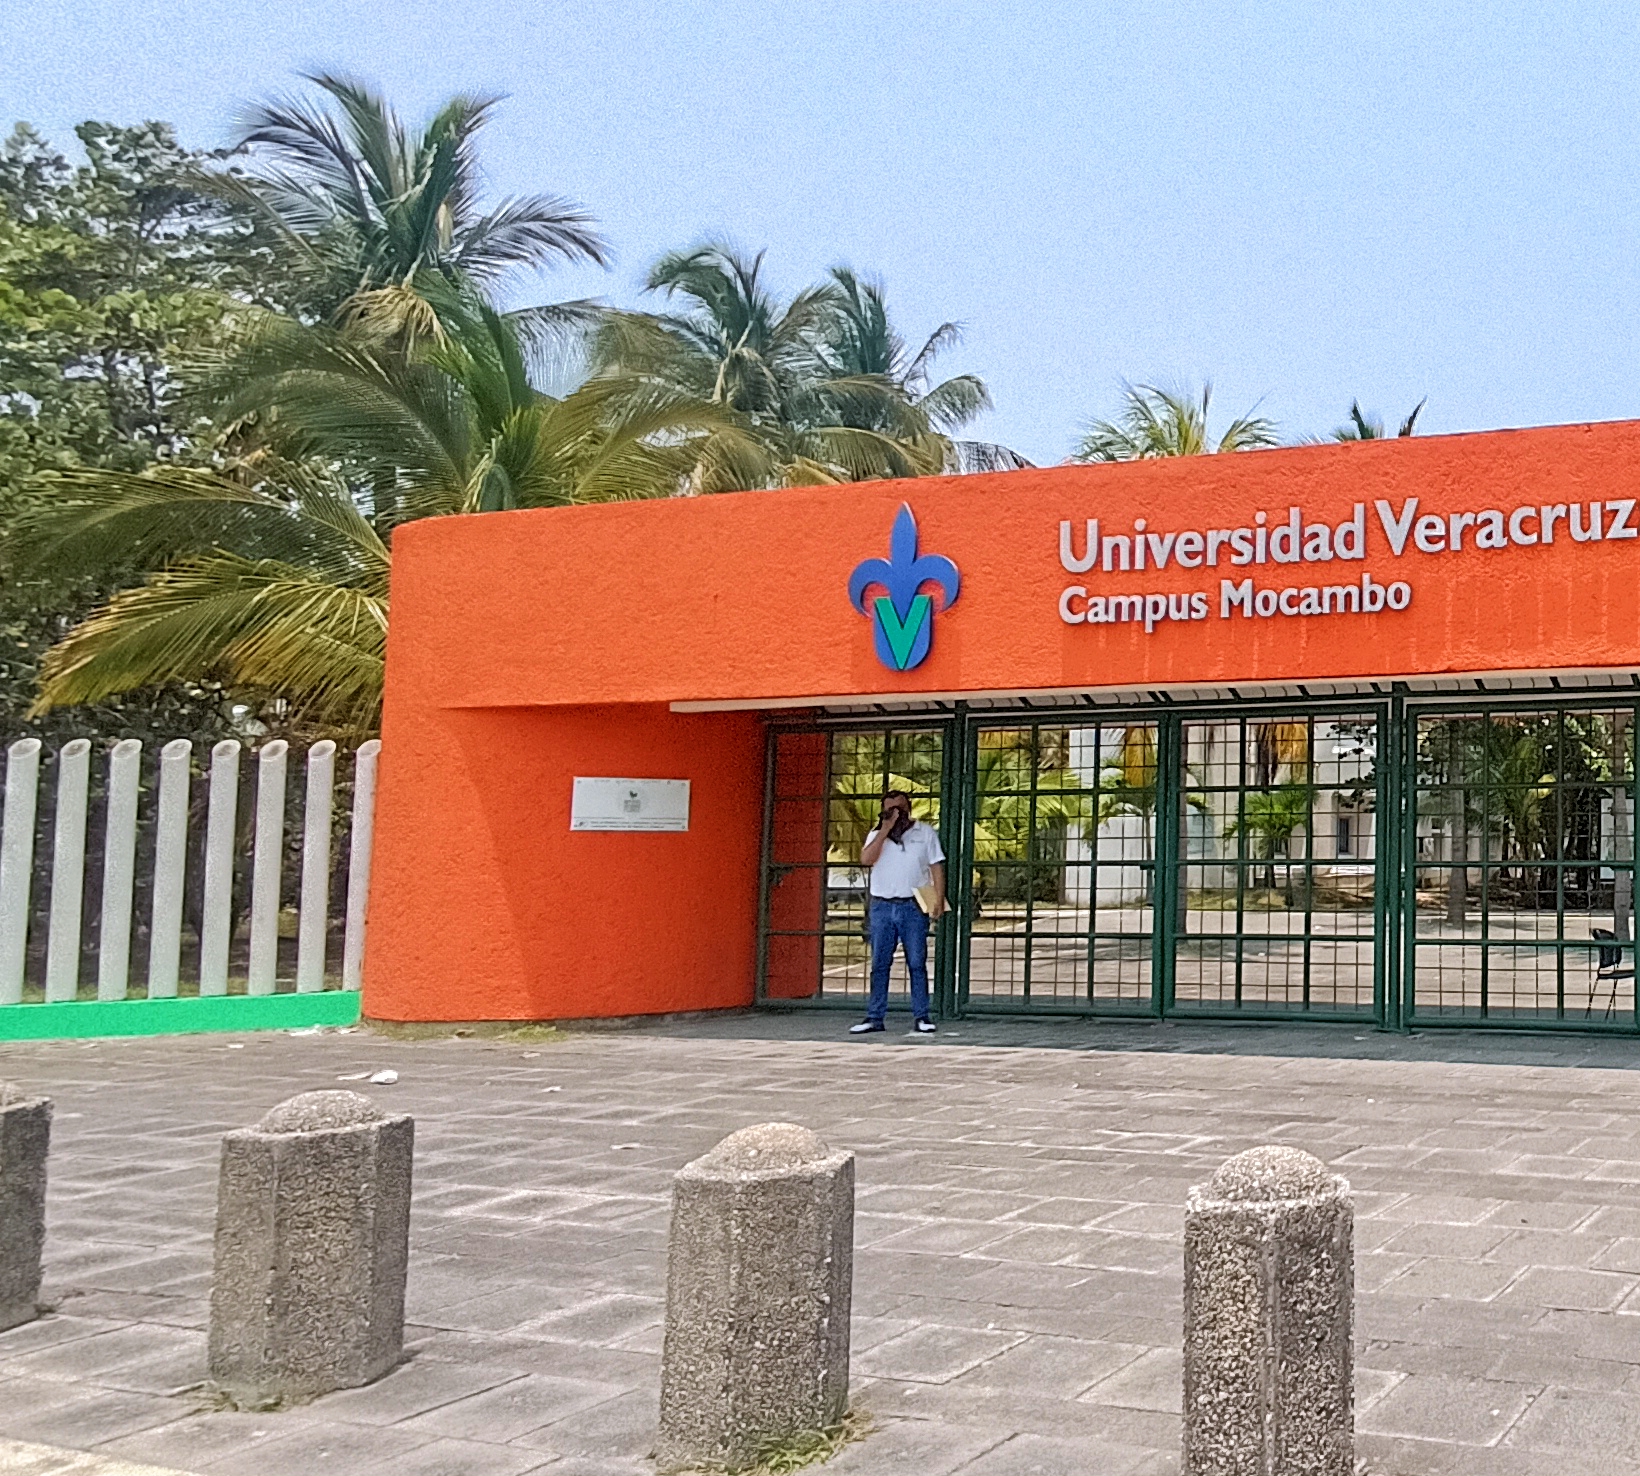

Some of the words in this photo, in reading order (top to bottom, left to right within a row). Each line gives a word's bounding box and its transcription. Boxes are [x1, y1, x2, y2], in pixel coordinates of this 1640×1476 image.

[1059, 502, 1365, 573] Universidad
[1059, 585, 1209, 633] Campus
[1221, 572, 1412, 618] Mocambo
